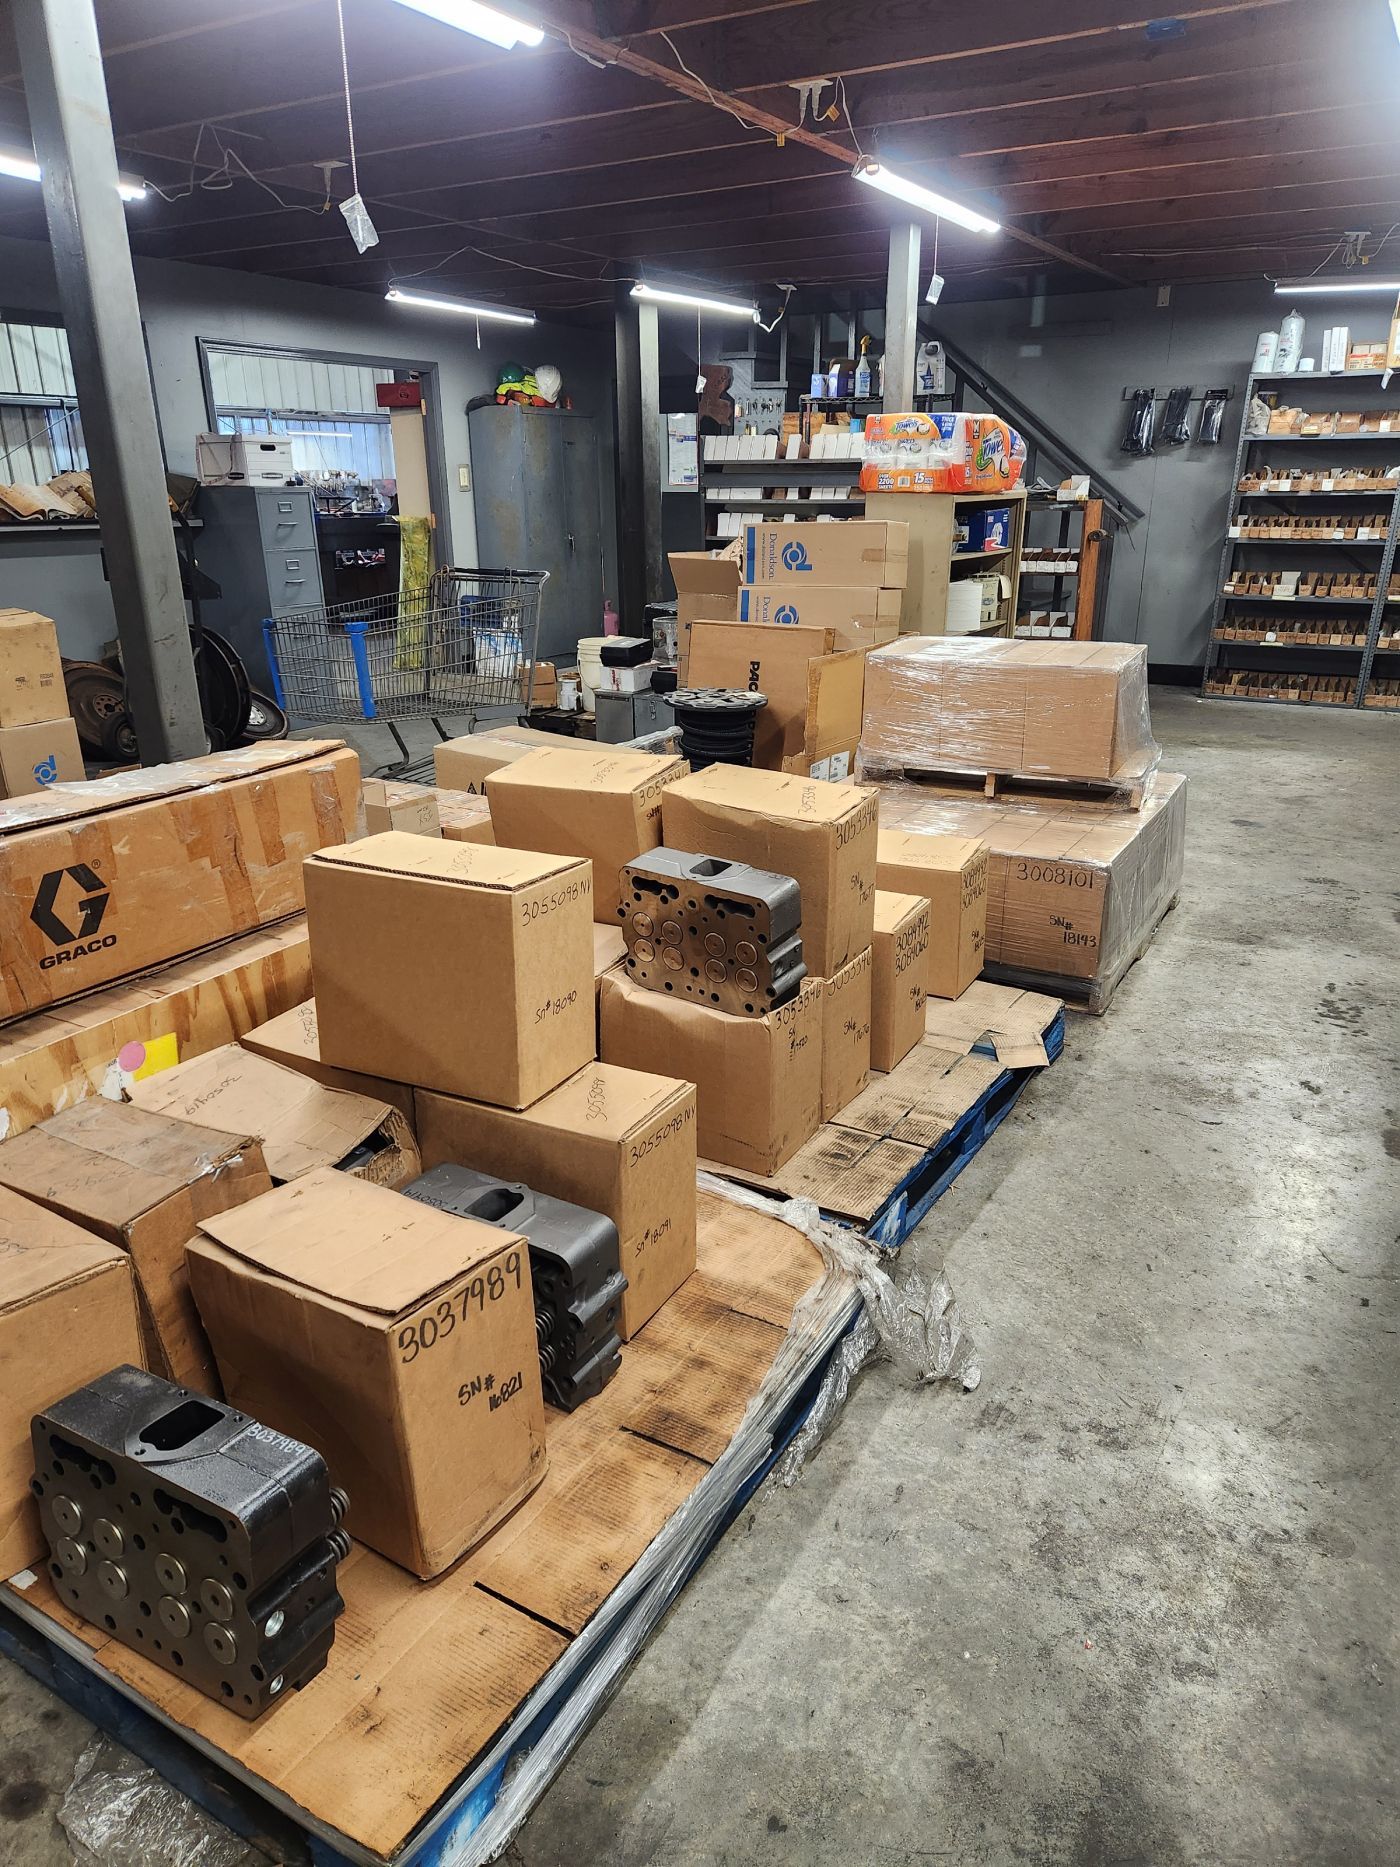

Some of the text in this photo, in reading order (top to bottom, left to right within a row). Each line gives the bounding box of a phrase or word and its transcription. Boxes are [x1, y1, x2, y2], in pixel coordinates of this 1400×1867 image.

[914, 472, 925, 484] 15
[749, 661, 760, 692] PAC
[835, 799, 877, 851] 3053346
[1016, 862, 1094, 889] 3008101
[39, 934, 117, 970] GRACO
[1062, 931, 1097, 948] 18143
[552, 990, 577, 1015] 18090
[775, 983, 821, 1030] 3053346
[650, 1217, 672, 1246] 18091
[398, 1251, 521, 1364] 3037989
